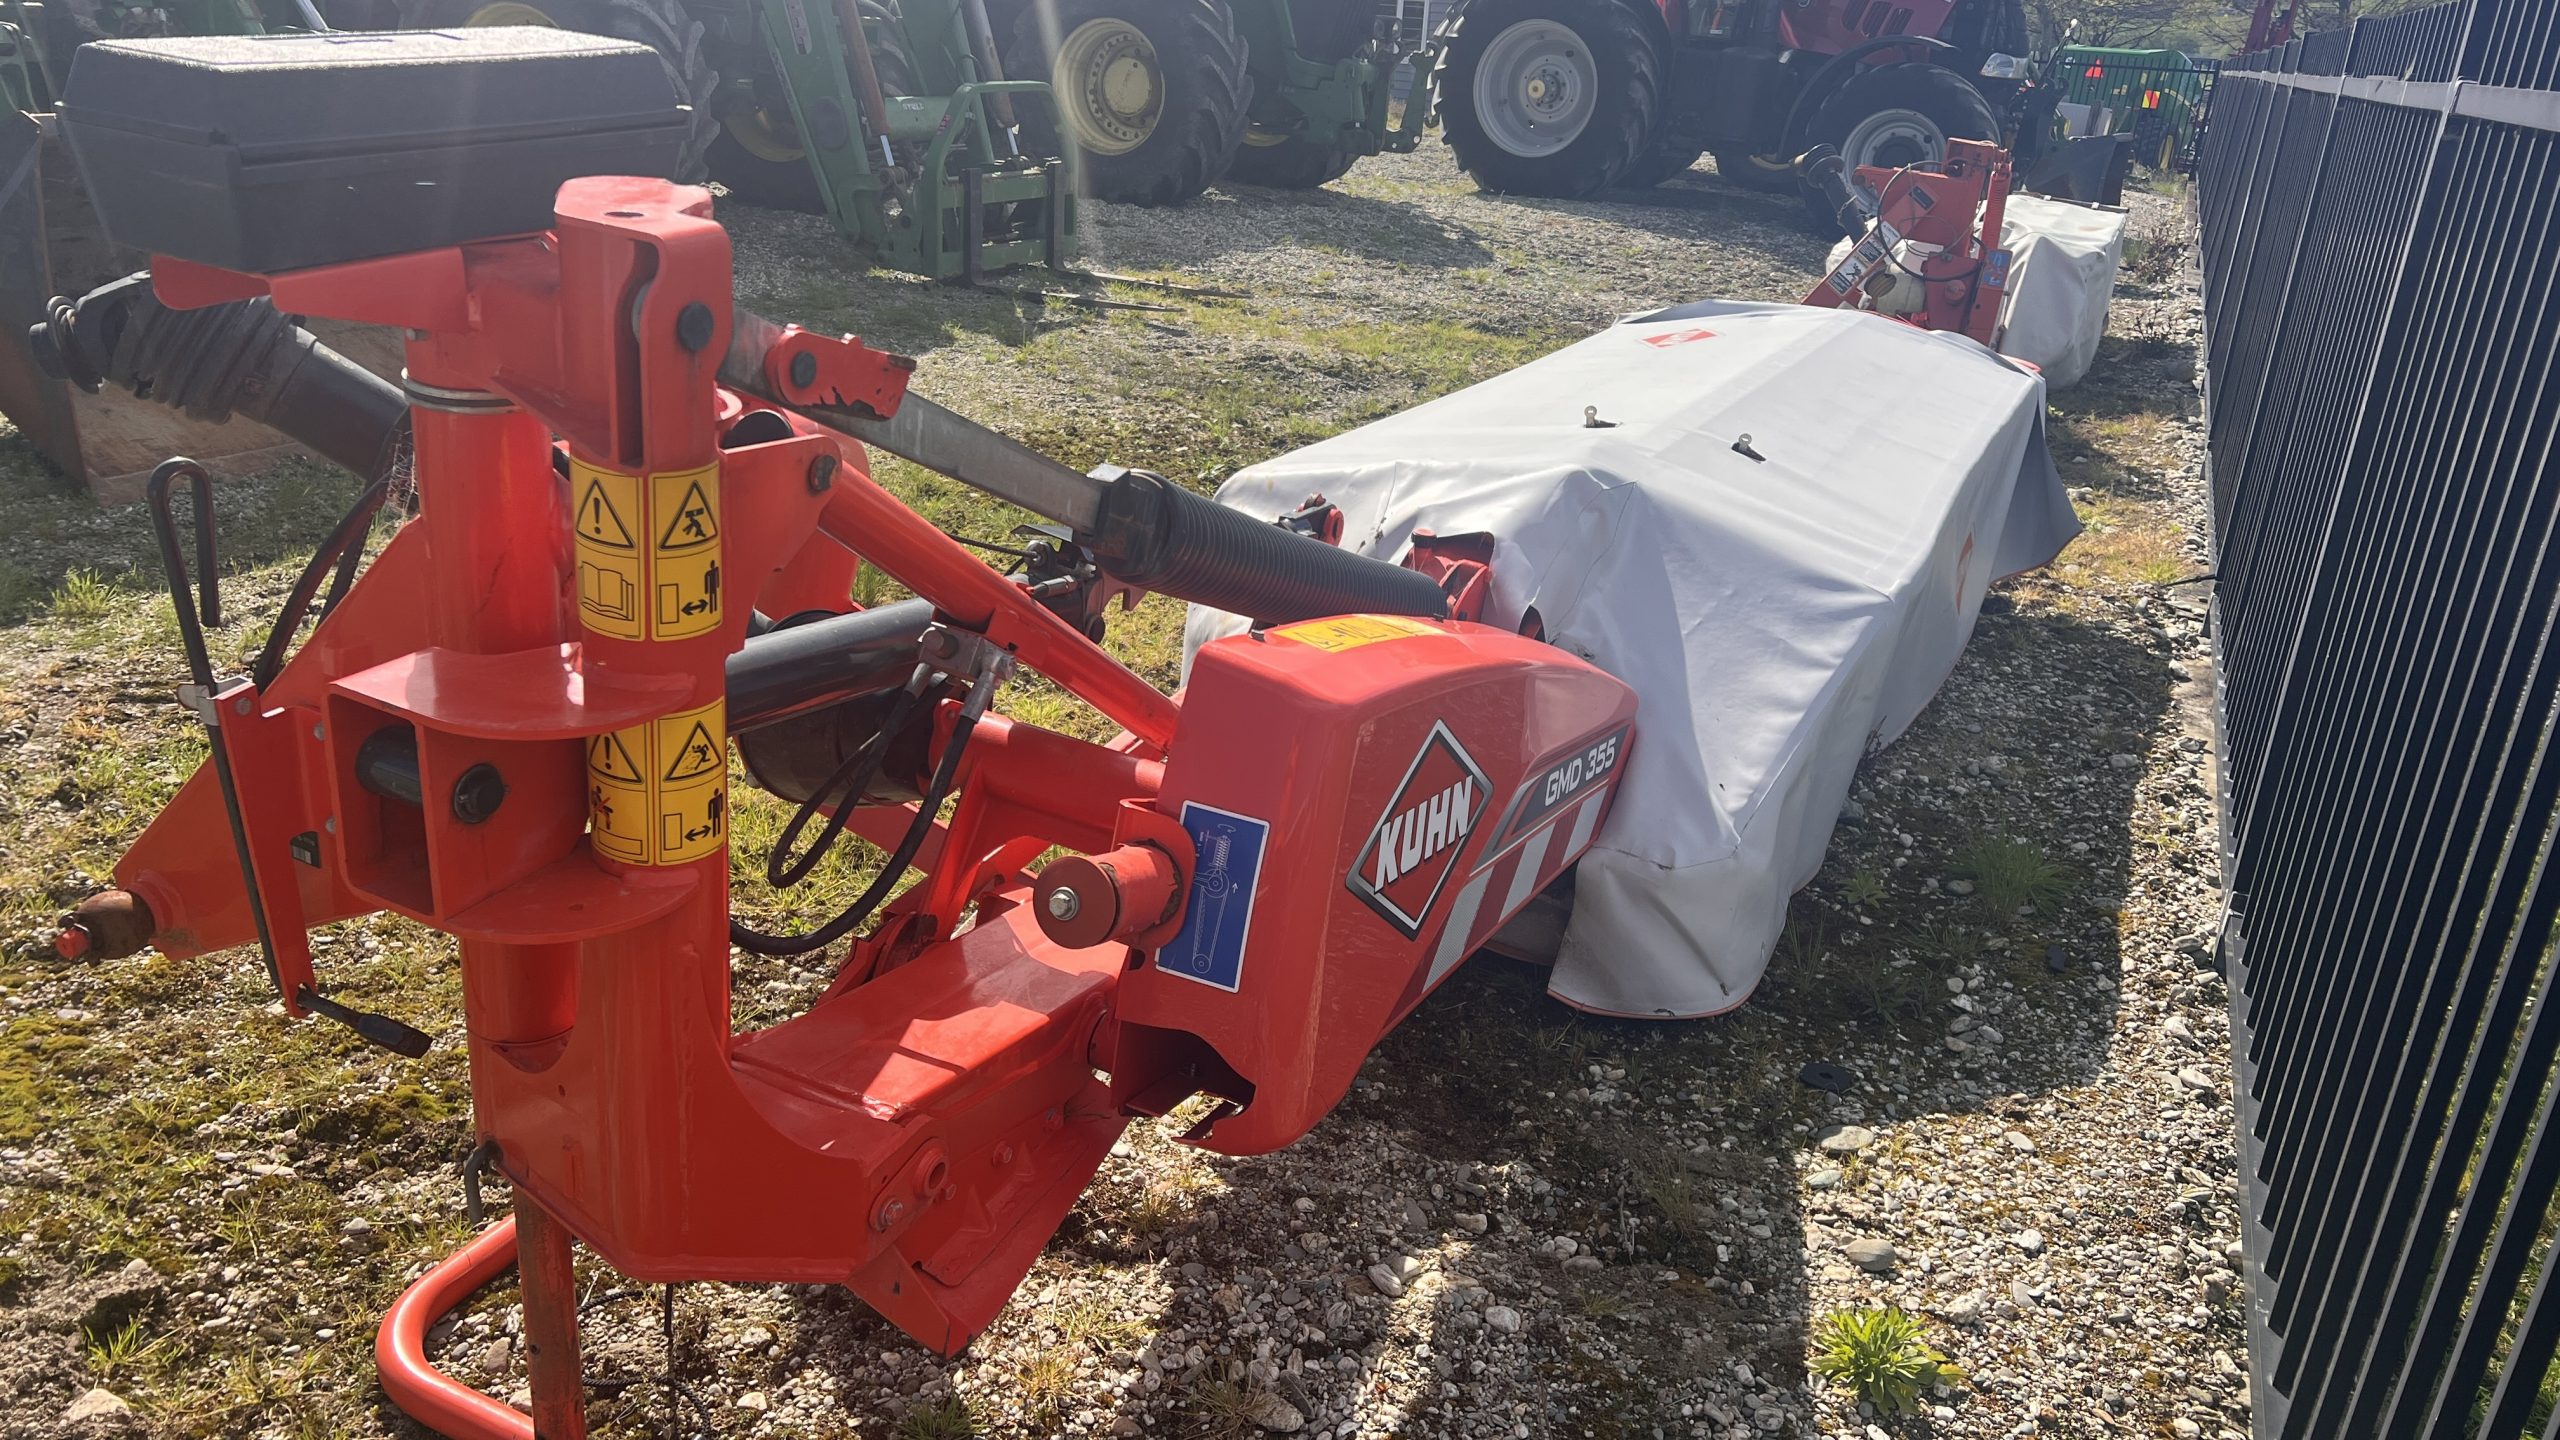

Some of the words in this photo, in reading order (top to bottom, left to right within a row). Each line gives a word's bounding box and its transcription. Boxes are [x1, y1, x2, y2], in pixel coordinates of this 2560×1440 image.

[1545, 757, 1583, 807] GMD
[1585, 736, 1617, 781] 355
[1374, 774, 1473, 893] KUHN
